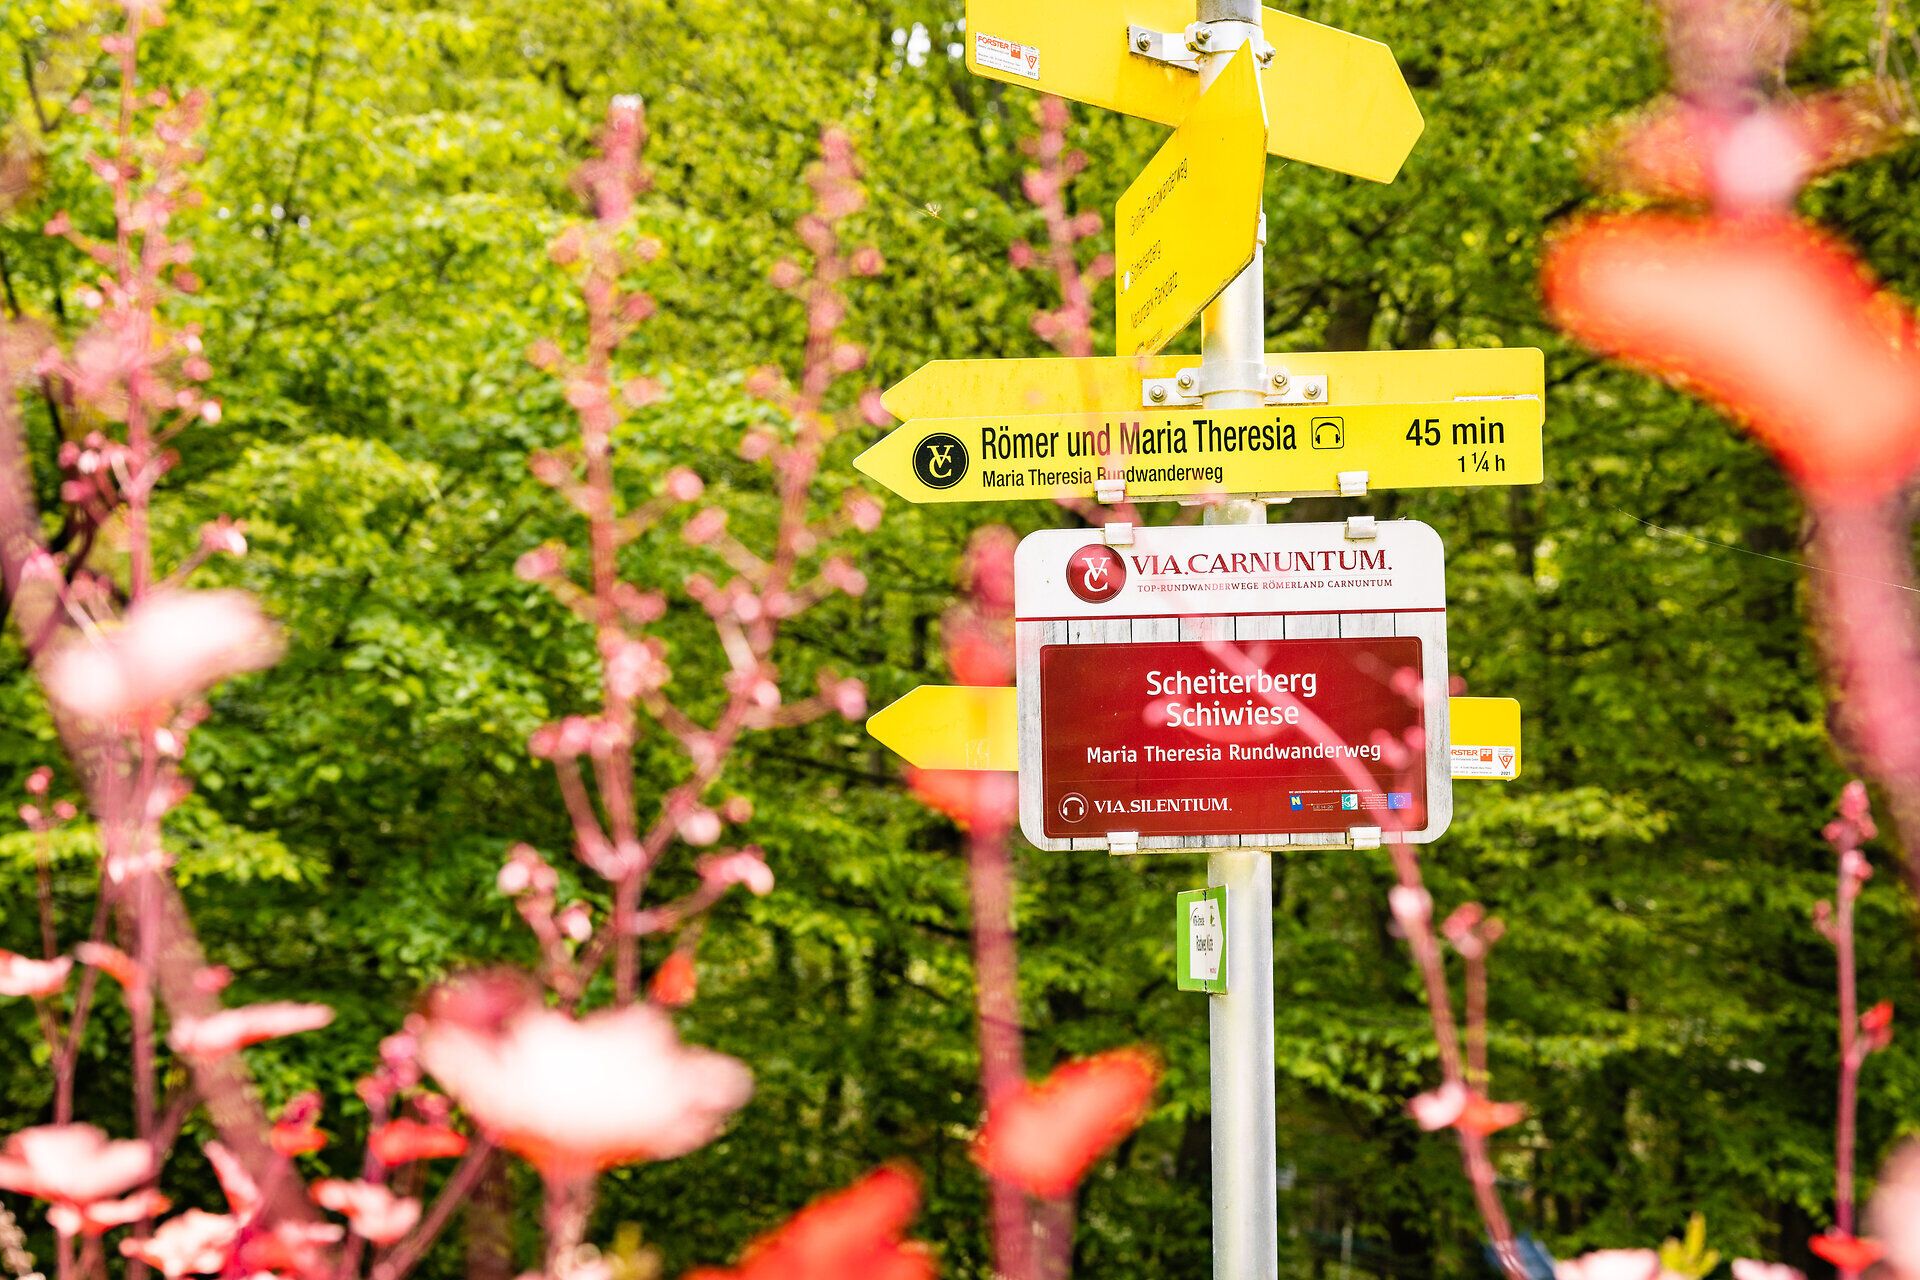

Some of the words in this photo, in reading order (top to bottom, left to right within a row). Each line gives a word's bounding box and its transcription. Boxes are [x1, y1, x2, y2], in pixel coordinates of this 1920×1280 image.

[978, 35, 1009, 50] FORSTER
[981, 425, 1059, 460] Römer
[1067, 423, 1110, 458] und
[1120, 420, 1187, 455] Maria
[1193, 417, 1297, 453] Theresia
[1405, 418, 1441, 447] 45
[1452, 416, 1505, 446] min
[1495, 454, 1505, 472] h
[982, 468, 1025, 488] Maria
[1028, 467, 1092, 486] Theresia
[1097, 465, 1223, 483] Rundwanderweg
[1131, 549, 1393, 575] VIA.CARNUNTUM.
[1137, 582, 1259, 593] TOP-RUNDWANDERWEGE
[1262, 579, 1324, 590] RÖMERLAND
[1327, 578, 1393, 589] CARNUNTUM
[1146, 668, 1317, 698] Scheiterberg
[1166, 700, 1300, 728] Schiwiese
[1087, 745, 1138, 764] Maria
[1143, 743, 1222, 763] Theresia
[1229, 742, 1381, 762] Rundwanderweg
[1094, 797, 1233, 813] VIA.SILENTIUM.
